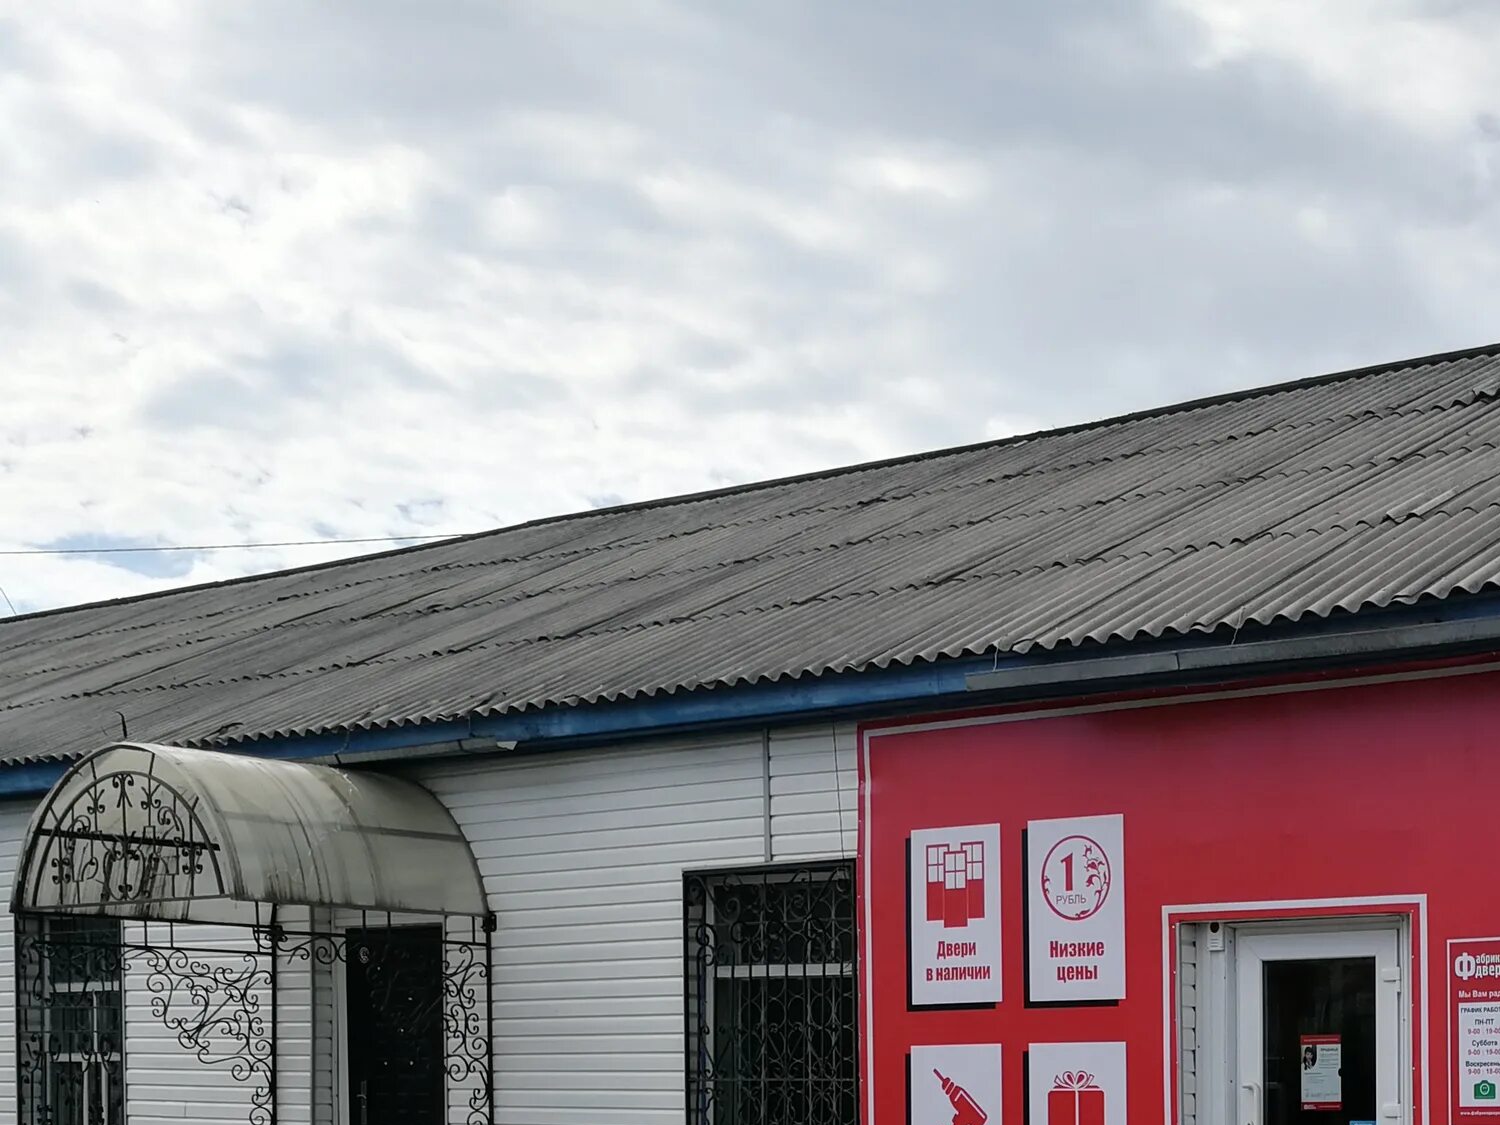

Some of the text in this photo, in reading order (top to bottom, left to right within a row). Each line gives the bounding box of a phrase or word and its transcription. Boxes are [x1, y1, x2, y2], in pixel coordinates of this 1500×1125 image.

[1060, 852, 1074, 892] 1
[1055, 892, 1087, 906] РУБЛЬ
[936, 940, 977, 960] Двери
[1049, 939, 1105, 958] Низкие
[926, 962, 991, 982] в наличии
[1056, 962, 1098, 983] цены
[1458, 990, 1471, 998] Мы
[1472, 990, 1487, 998] Вам
[1472, 1039, 1498, 1047] Суббота
